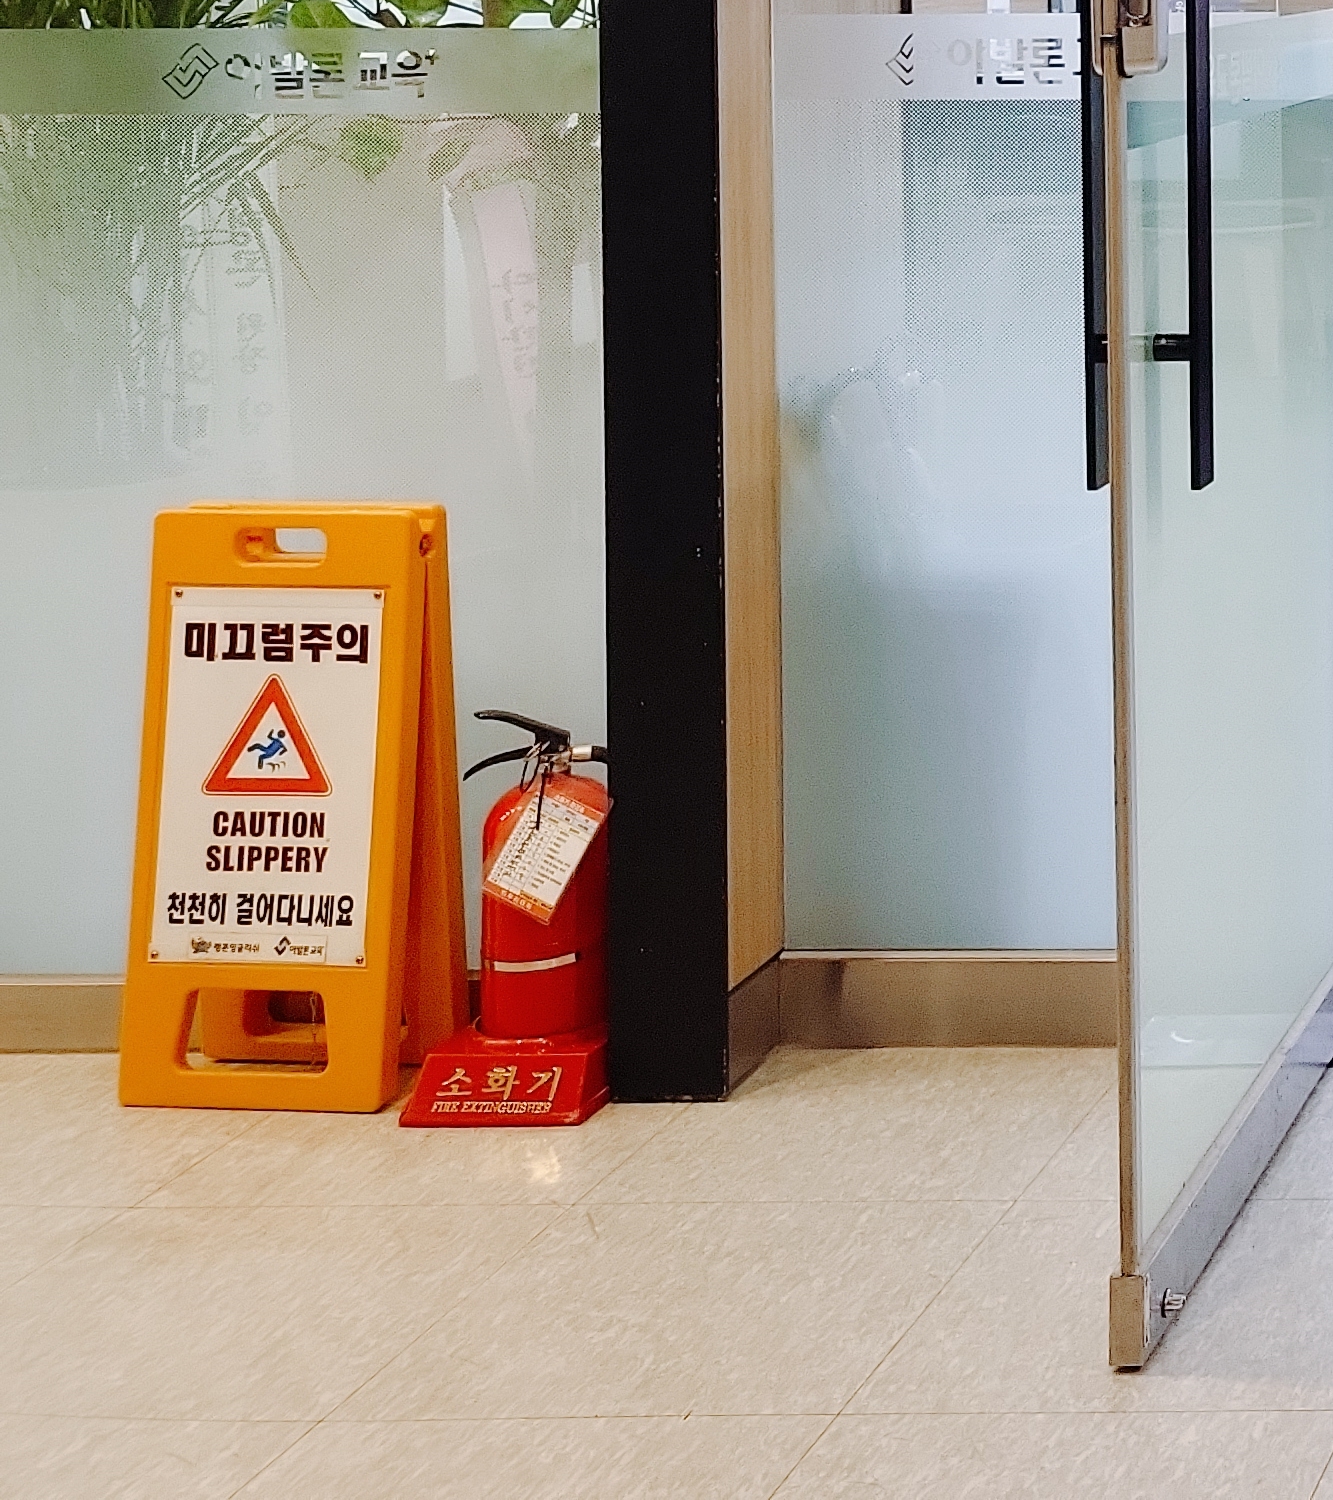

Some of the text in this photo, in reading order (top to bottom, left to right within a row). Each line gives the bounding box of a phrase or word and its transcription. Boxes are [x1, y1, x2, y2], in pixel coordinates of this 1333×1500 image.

[183, 621, 370, 664] 미끄럼주의
[212, 810, 326, 839] CAUTION
[205, 844, 330, 874] SLIPPERY
[166, 891, 354, 928] 천천히 걸어다니세요
[435, 1064, 563, 1101] 소화기
[430, 1101, 553, 1114] FIRE EXTINGUISHER
